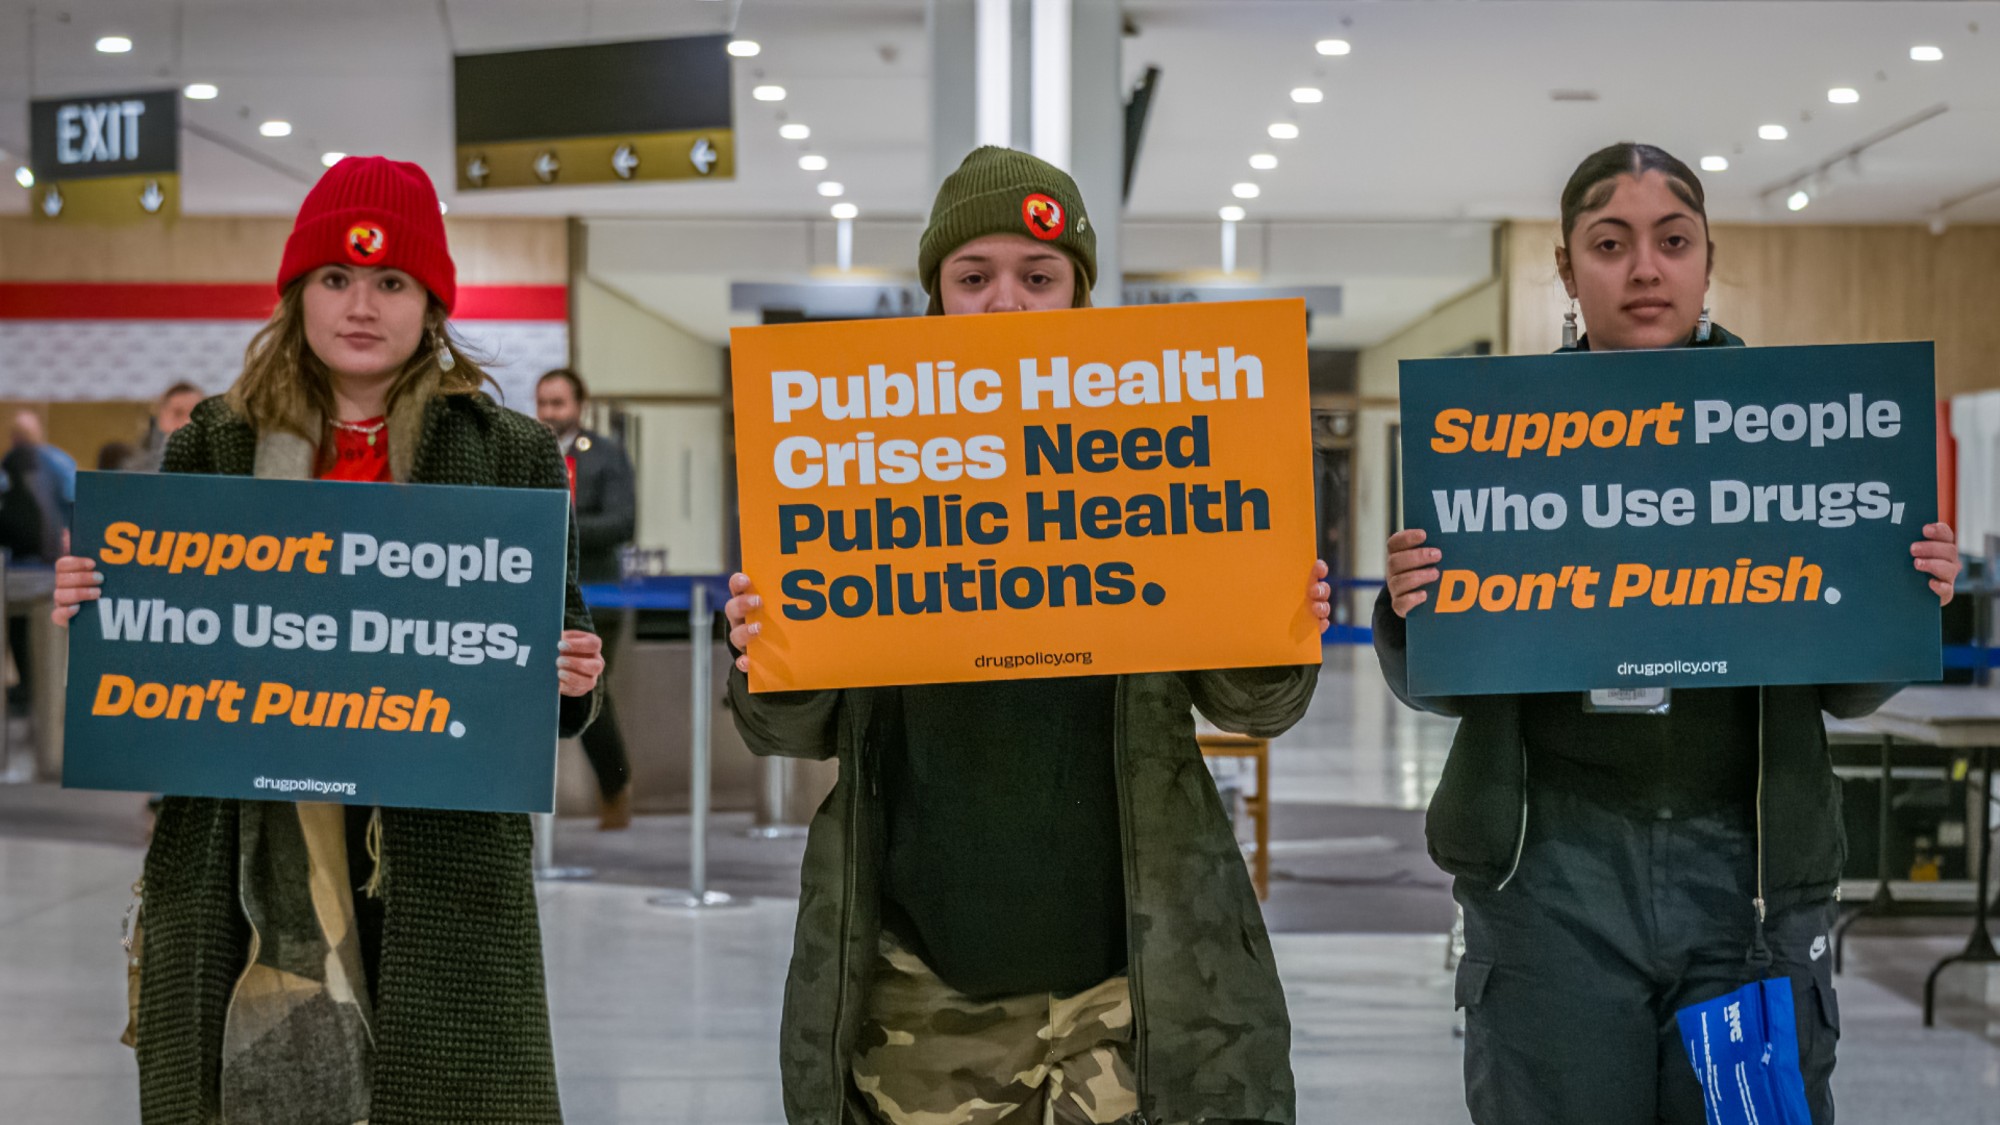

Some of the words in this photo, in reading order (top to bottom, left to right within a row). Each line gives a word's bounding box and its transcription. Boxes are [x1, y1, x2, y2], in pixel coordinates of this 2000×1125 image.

[57, 100, 145, 163] EXIT
[770, 360, 1003, 423] Public
[1019, 346, 1265, 411] Health
[773, 431, 1007, 490] Crises
[1023, 415, 1211, 476] Need
[1430, 401, 1684, 458] Support
[1694, 393, 1901, 447] People
[778, 493, 1009, 555] Public
[1025, 479, 1271, 542] Health
[1431, 486, 1568, 533] Who
[1581, 483, 1695, 529] Use
[1710, 479, 1905, 528] Drugs,
[99, 521, 334, 576] Support
[340, 532, 533, 587] People
[1434, 565, 1600, 613] Don't
[1609, 556, 1842, 608] Punish.
[781, 558, 1166, 621] Solutions.
[98, 597, 221, 645] Who
[233, 604, 338, 651] Use
[350, 609, 531, 667] Drugs,
[975, 652, 1093, 668] drugpolicy.org
[1617, 660, 1728, 676] drugpolicy.org
[92, 674, 246, 723] Don't
[251, 682, 466, 738] Punish.
[253, 776, 357, 796] drugpolicy.org
[1727, 1001, 1743, 1043] NYC
